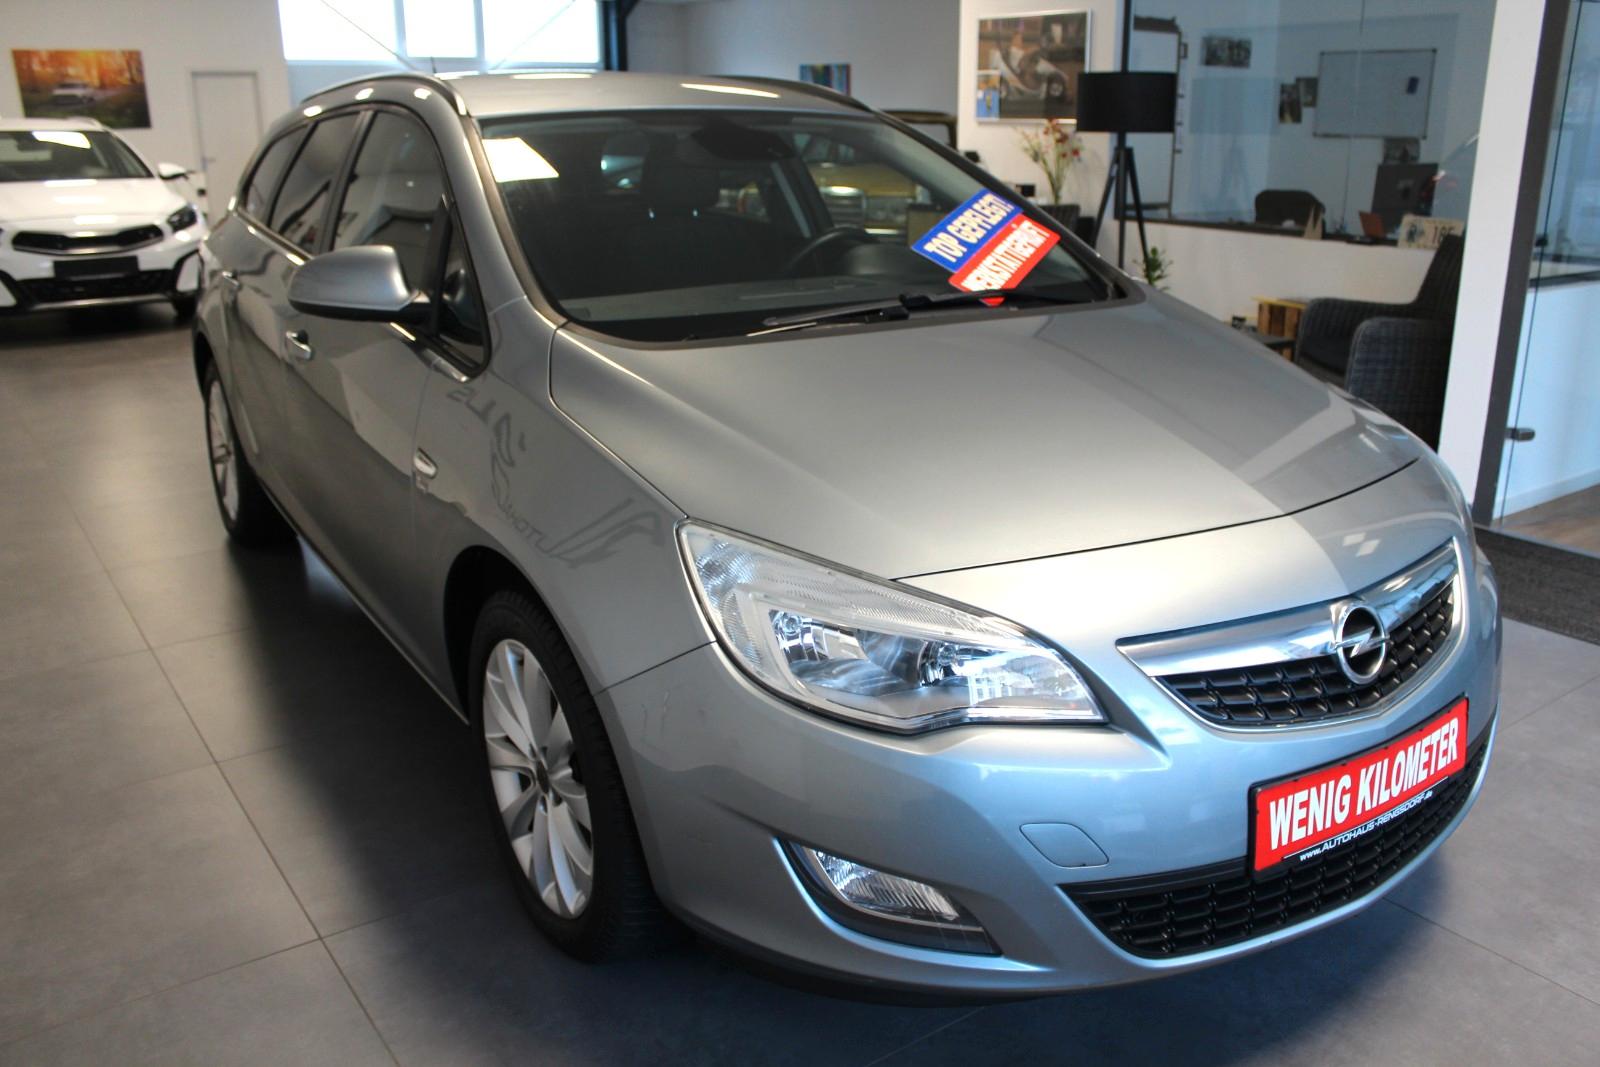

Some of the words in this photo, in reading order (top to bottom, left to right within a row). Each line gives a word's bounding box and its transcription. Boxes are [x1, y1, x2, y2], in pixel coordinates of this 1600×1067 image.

[923, 232, 967, 263] TOP
[946, 193, 1015, 244] GEPFLEGT!
[1269, 775, 1352, 850] WENIG
[1356, 717, 1459, 816] KILOMETER
